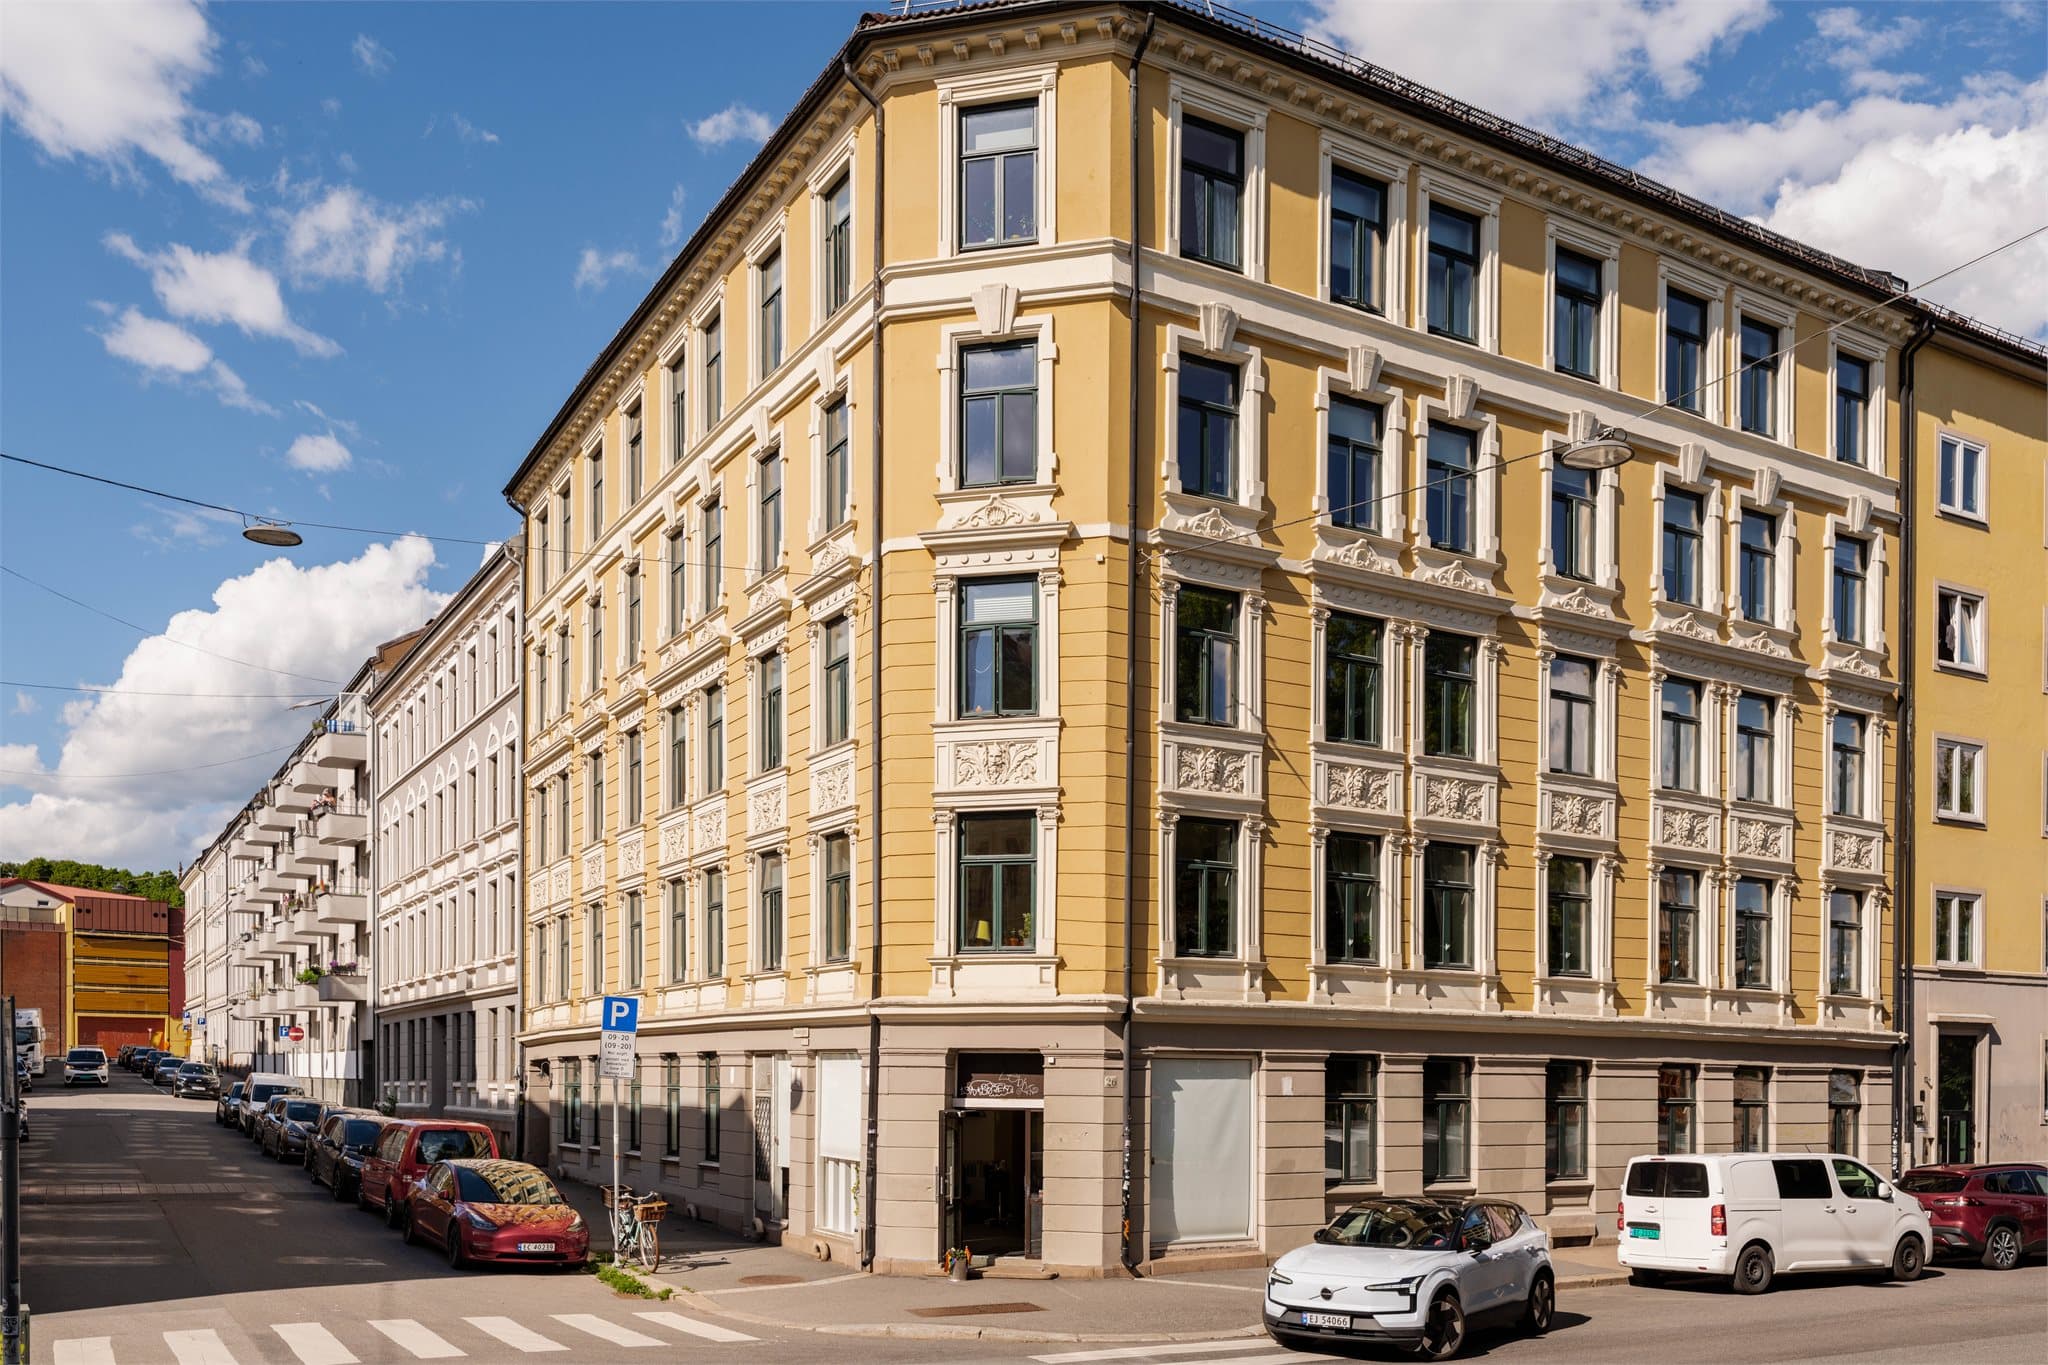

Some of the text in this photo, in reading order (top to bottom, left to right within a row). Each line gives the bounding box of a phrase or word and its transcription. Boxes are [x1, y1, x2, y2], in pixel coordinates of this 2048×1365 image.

[610, 1001, 630, 1027] P
[1309, 1314, 1348, 1327] EJ 54066
